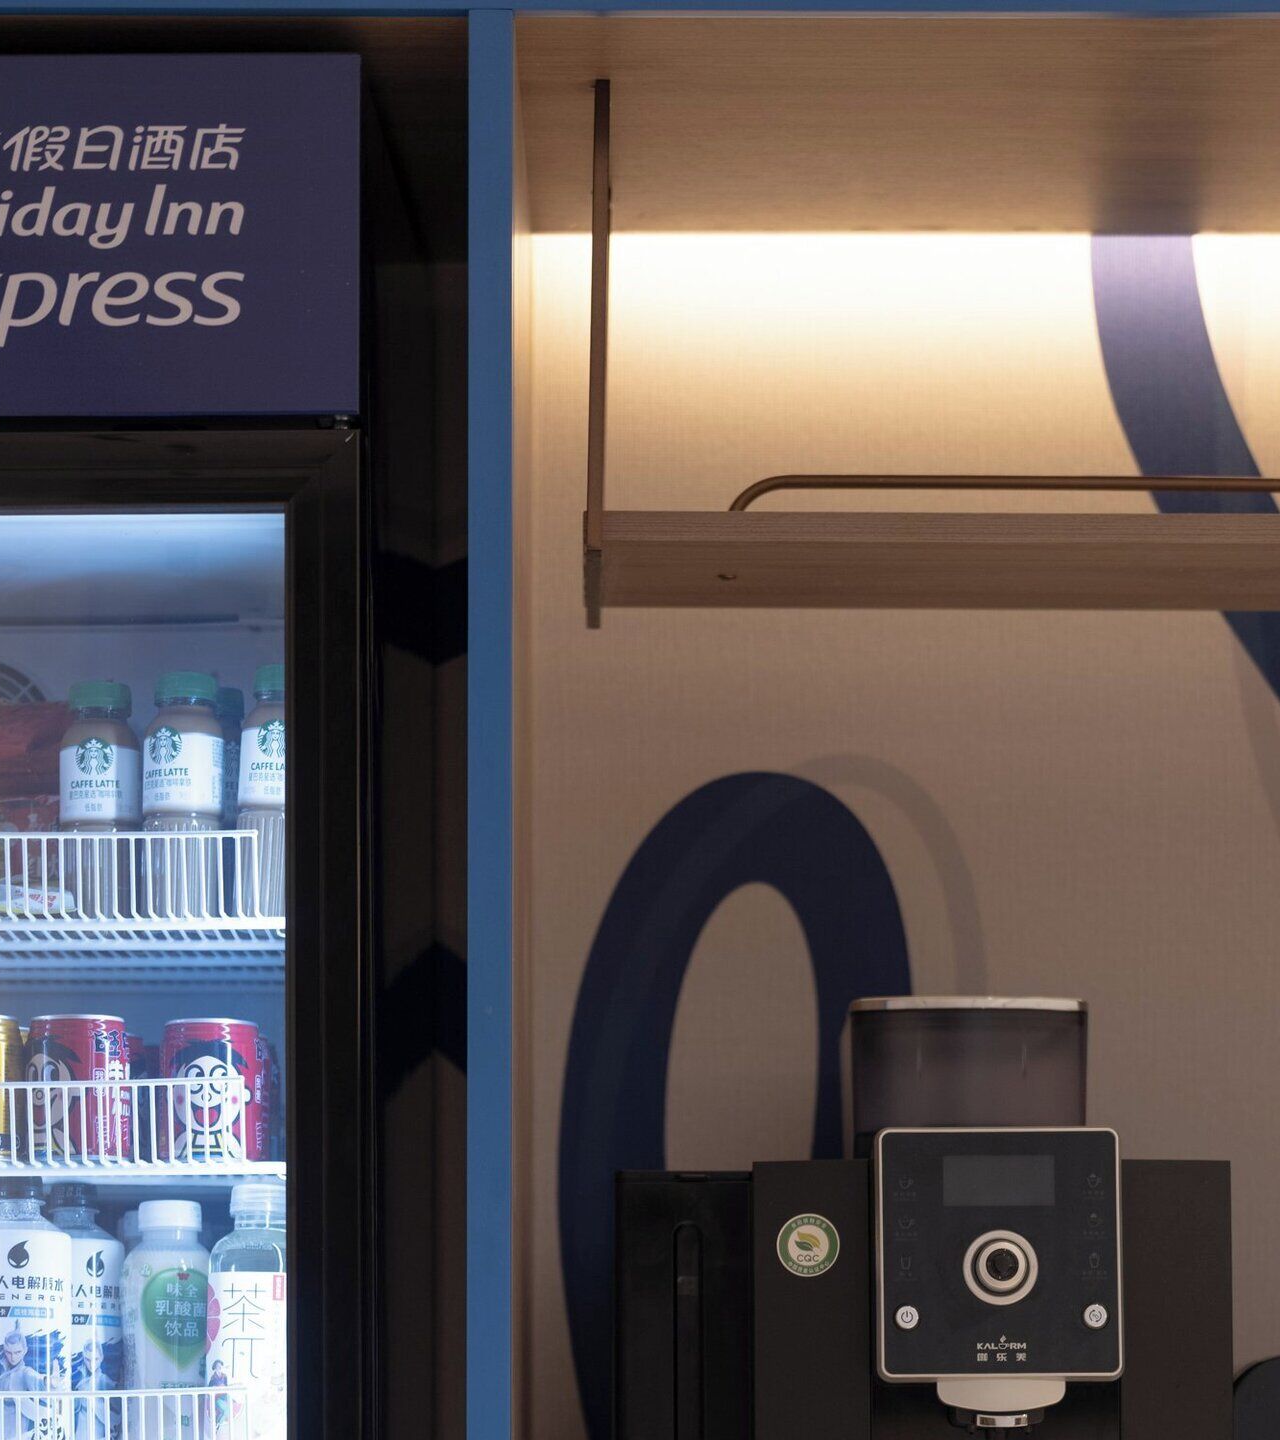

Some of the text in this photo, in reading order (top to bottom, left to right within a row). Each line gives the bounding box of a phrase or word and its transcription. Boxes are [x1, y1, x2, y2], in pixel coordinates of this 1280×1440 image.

[150, 185, 244, 238] Inn
[145, 767, 189, 779] CAFFE LATTE
[71, 780, 120, 789] CAFFE LATTE
[796, 1254, 820, 1263] CQC
[167, 1284, 198, 1298] 味全
[155, 1301, 207, 1318] 乳酸菌
[165, 1321, 199, 1337] 饮品
